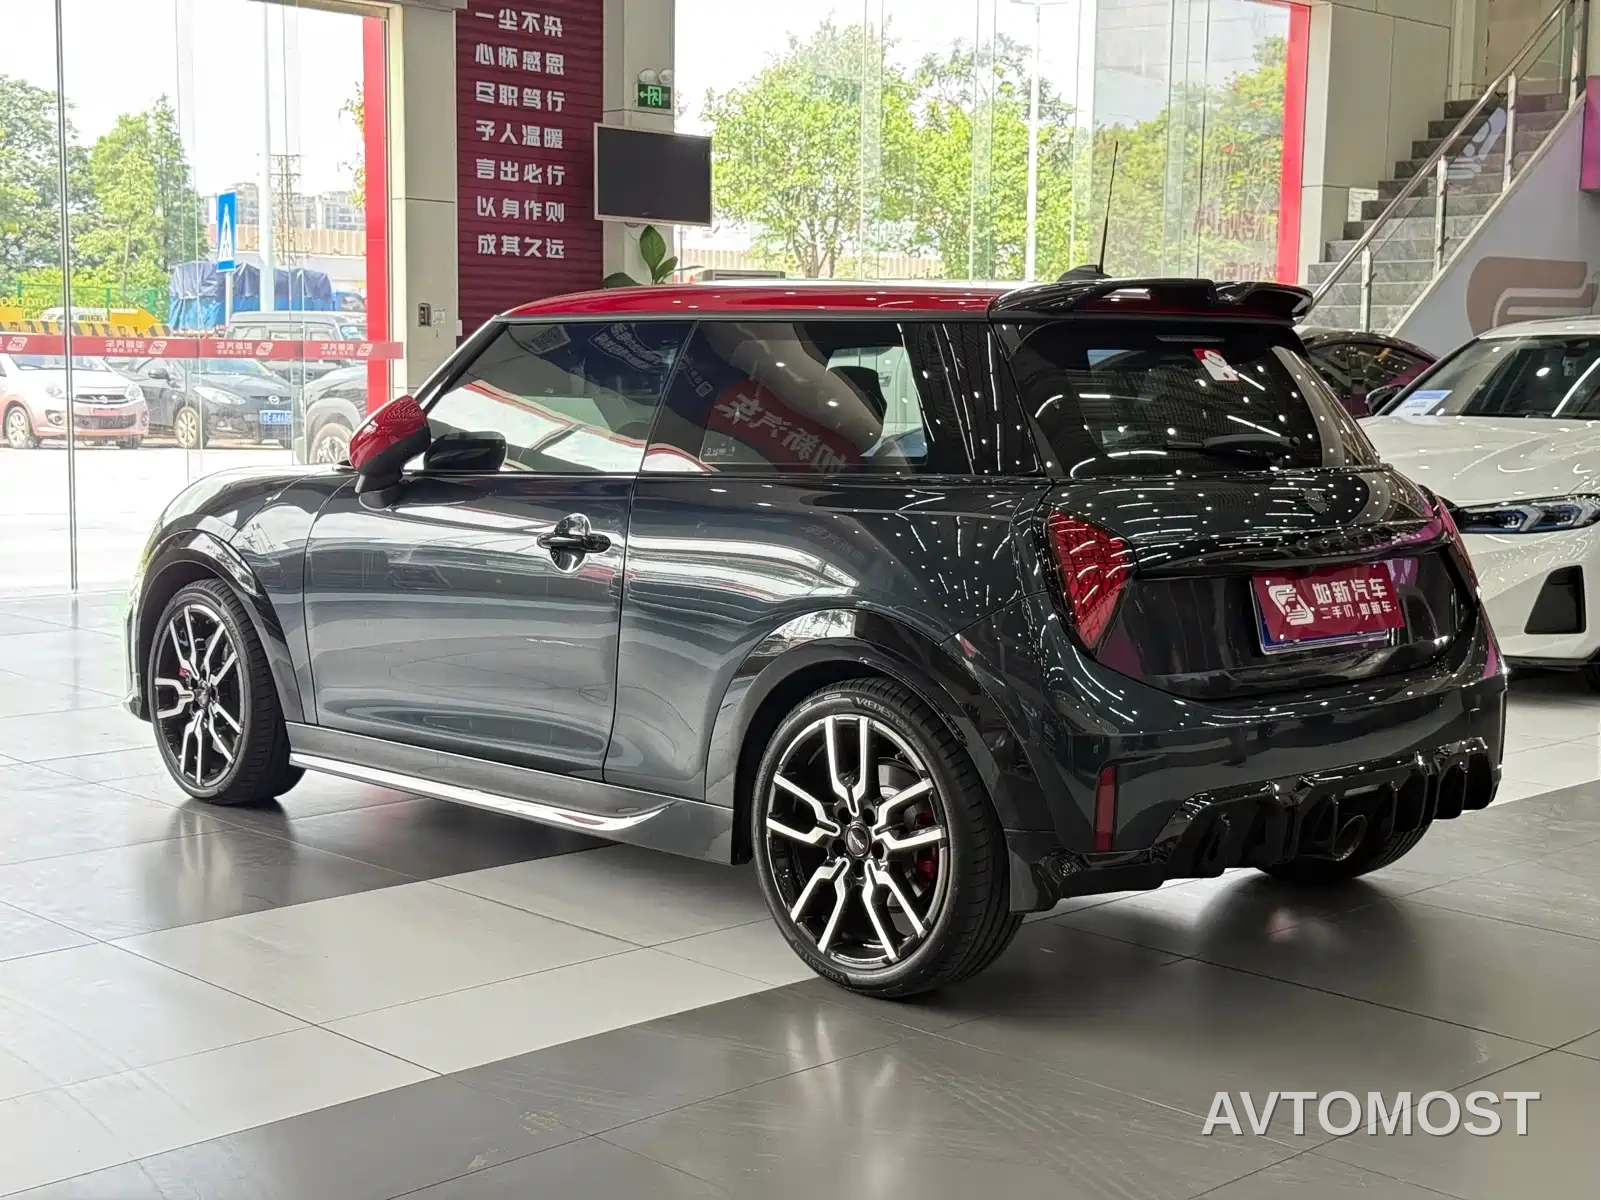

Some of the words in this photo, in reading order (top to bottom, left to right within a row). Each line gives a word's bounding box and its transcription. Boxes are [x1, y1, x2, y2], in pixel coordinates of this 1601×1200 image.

[475, 8, 563, 37] 一尘不染
[475, 43, 565, 76] 心怀感恩
[475, 81, 566, 113] 尽职笃行
[475, 119, 563, 150] 予人温暖
[475, 158, 566, 186] 言出必行
[476, 195, 565, 223] 以身作则
[477, 233, 565, 259] 成其久远
[1312, 578, 1388, 605] 如新汽车
